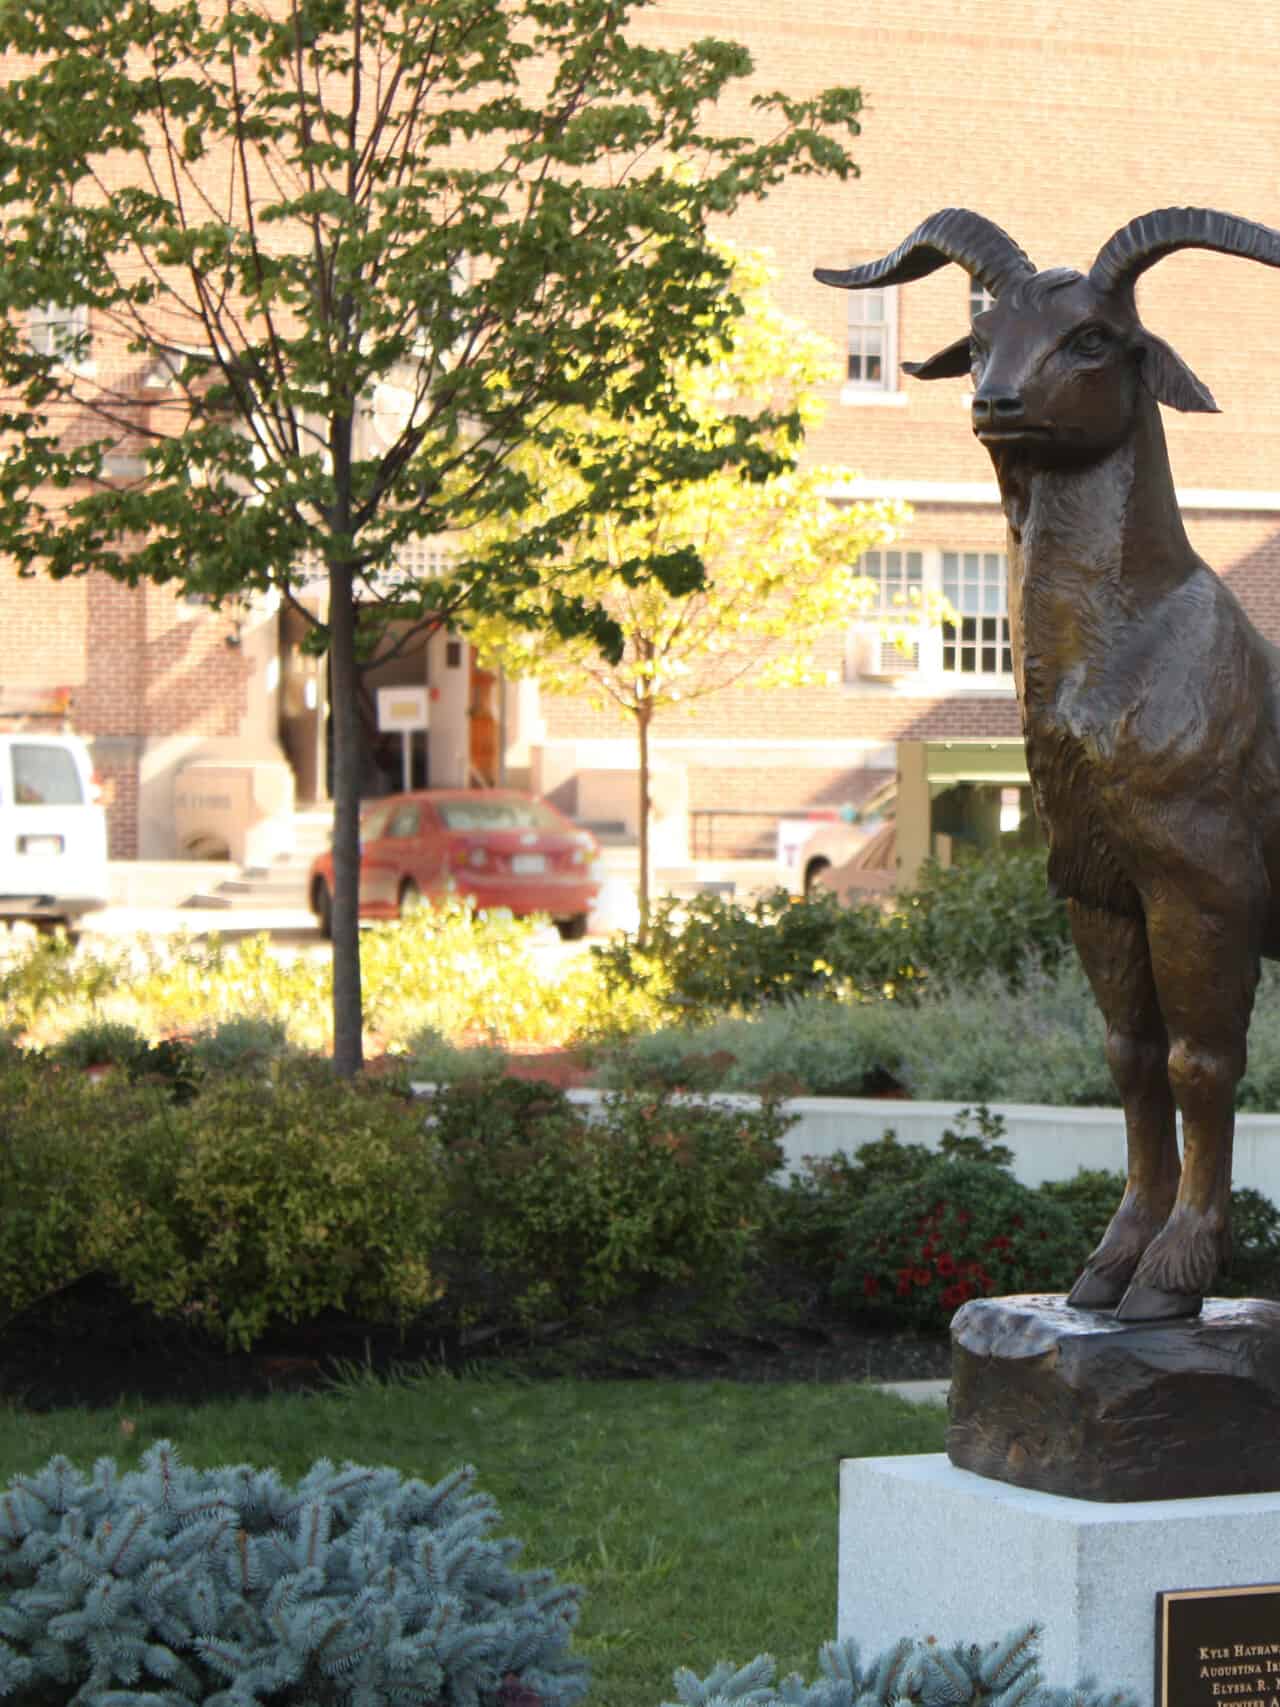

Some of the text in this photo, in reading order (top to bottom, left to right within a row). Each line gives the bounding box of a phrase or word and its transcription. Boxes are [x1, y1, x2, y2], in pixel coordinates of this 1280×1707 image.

[1199, 1647, 1229, 1660] KYLE
[1200, 1665, 1262, 1679] AUGUSTINA
[1257, 1680, 1270, 1692] R.
